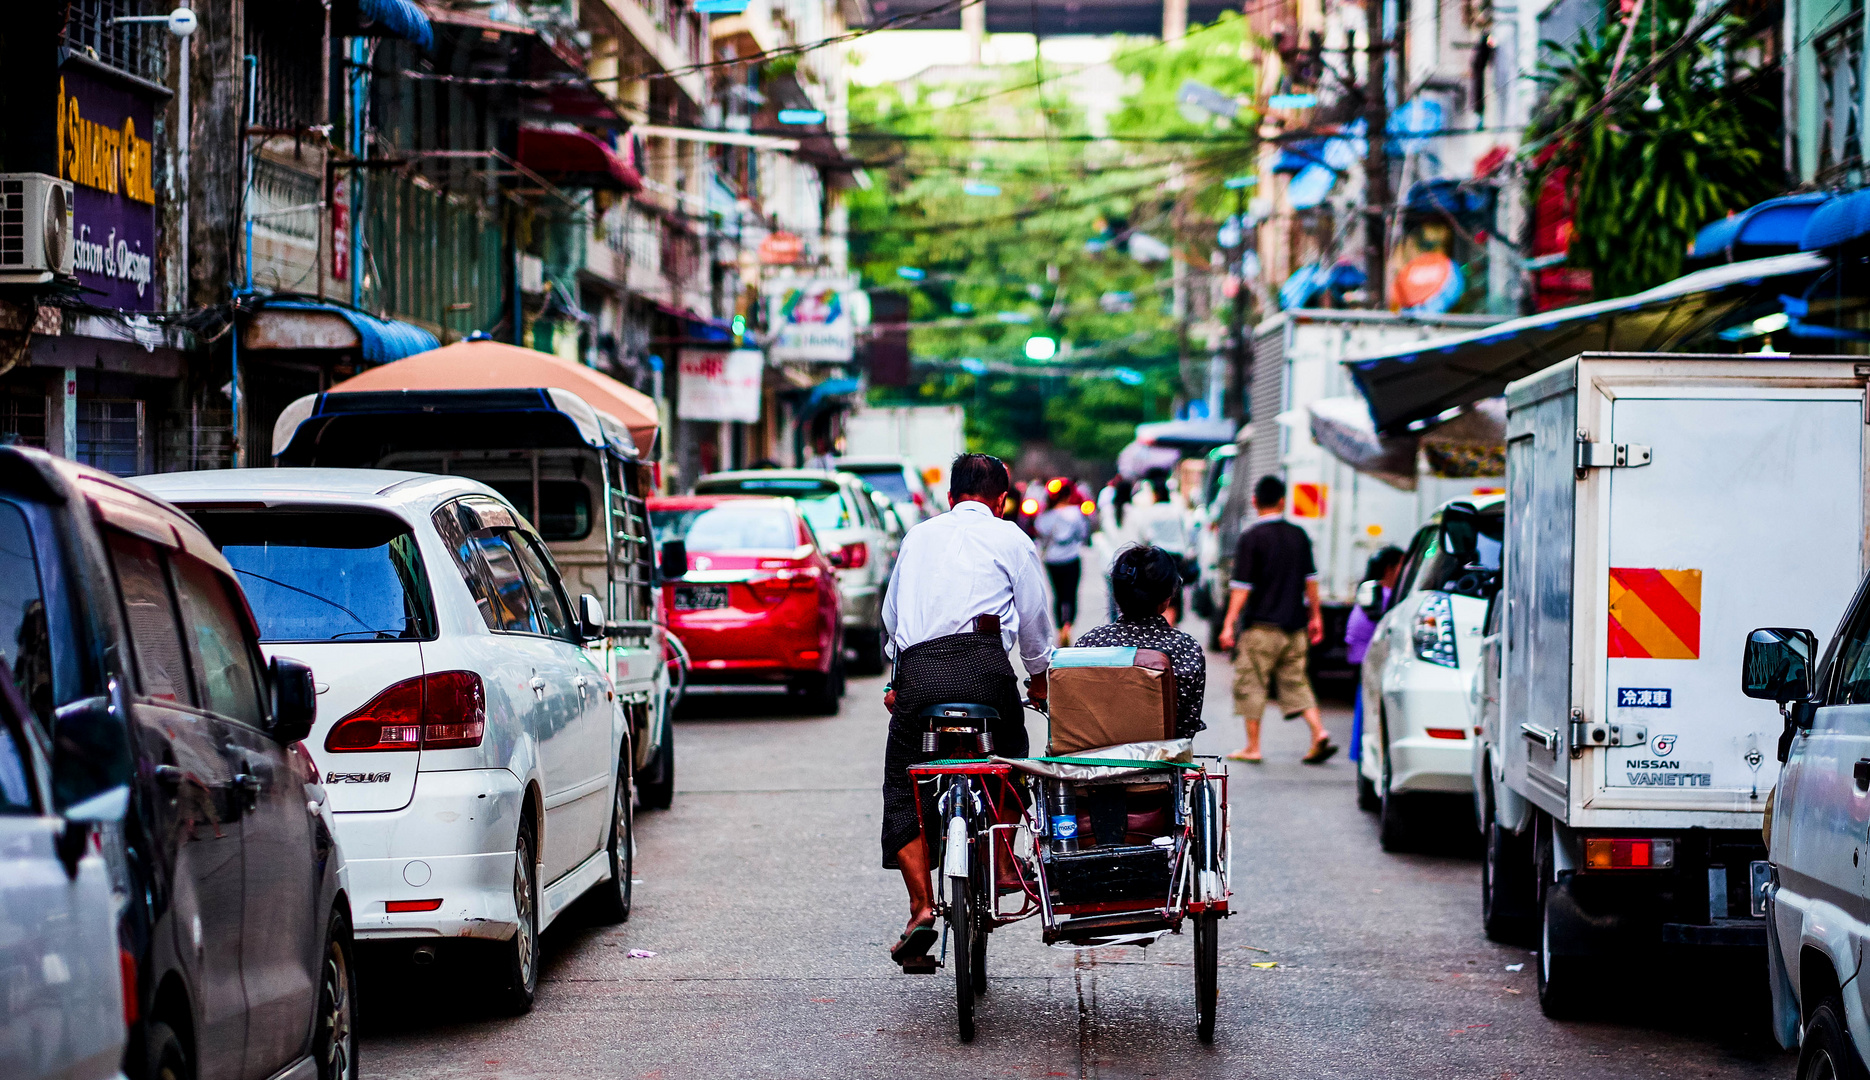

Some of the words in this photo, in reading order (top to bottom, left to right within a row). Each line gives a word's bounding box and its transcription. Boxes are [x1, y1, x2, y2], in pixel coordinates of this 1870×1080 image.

[73, 224, 103, 274] shion
[117, 239, 151, 297] Design
[1621, 689, 1668, 706] 冷凍車
[1626, 760, 1680, 769] NISSAN
[326, 771, 392, 784] IPSUM
[1626, 772, 1711, 786] VANETTE
